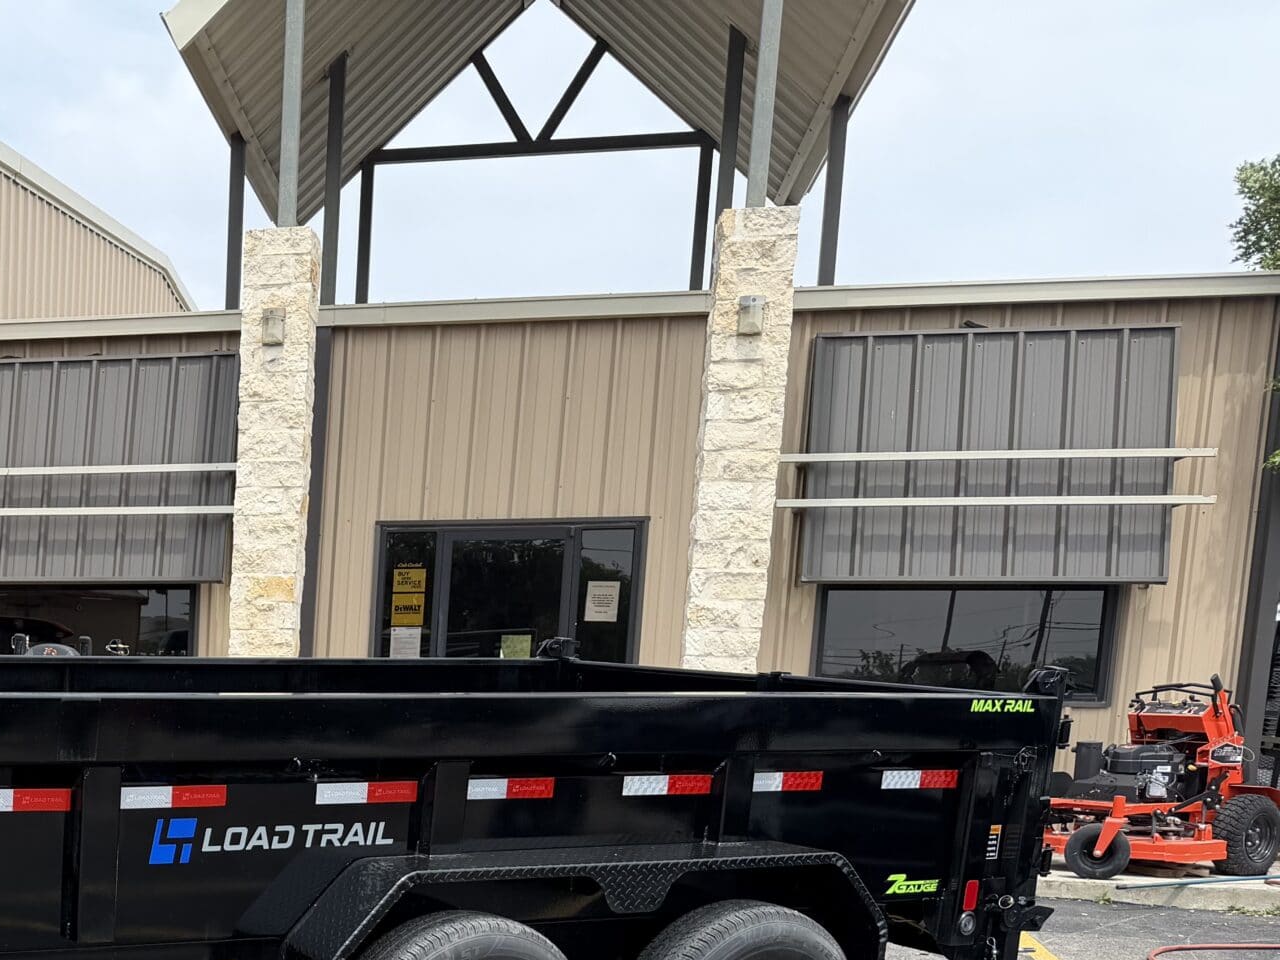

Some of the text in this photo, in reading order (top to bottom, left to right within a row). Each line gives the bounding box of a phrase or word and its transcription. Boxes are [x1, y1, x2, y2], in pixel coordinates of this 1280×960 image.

[970, 699, 1035, 713] MAX RAIL
[201, 821, 395, 852] LOAD TRAIL
[895, 882, 938, 894] GAUGE
